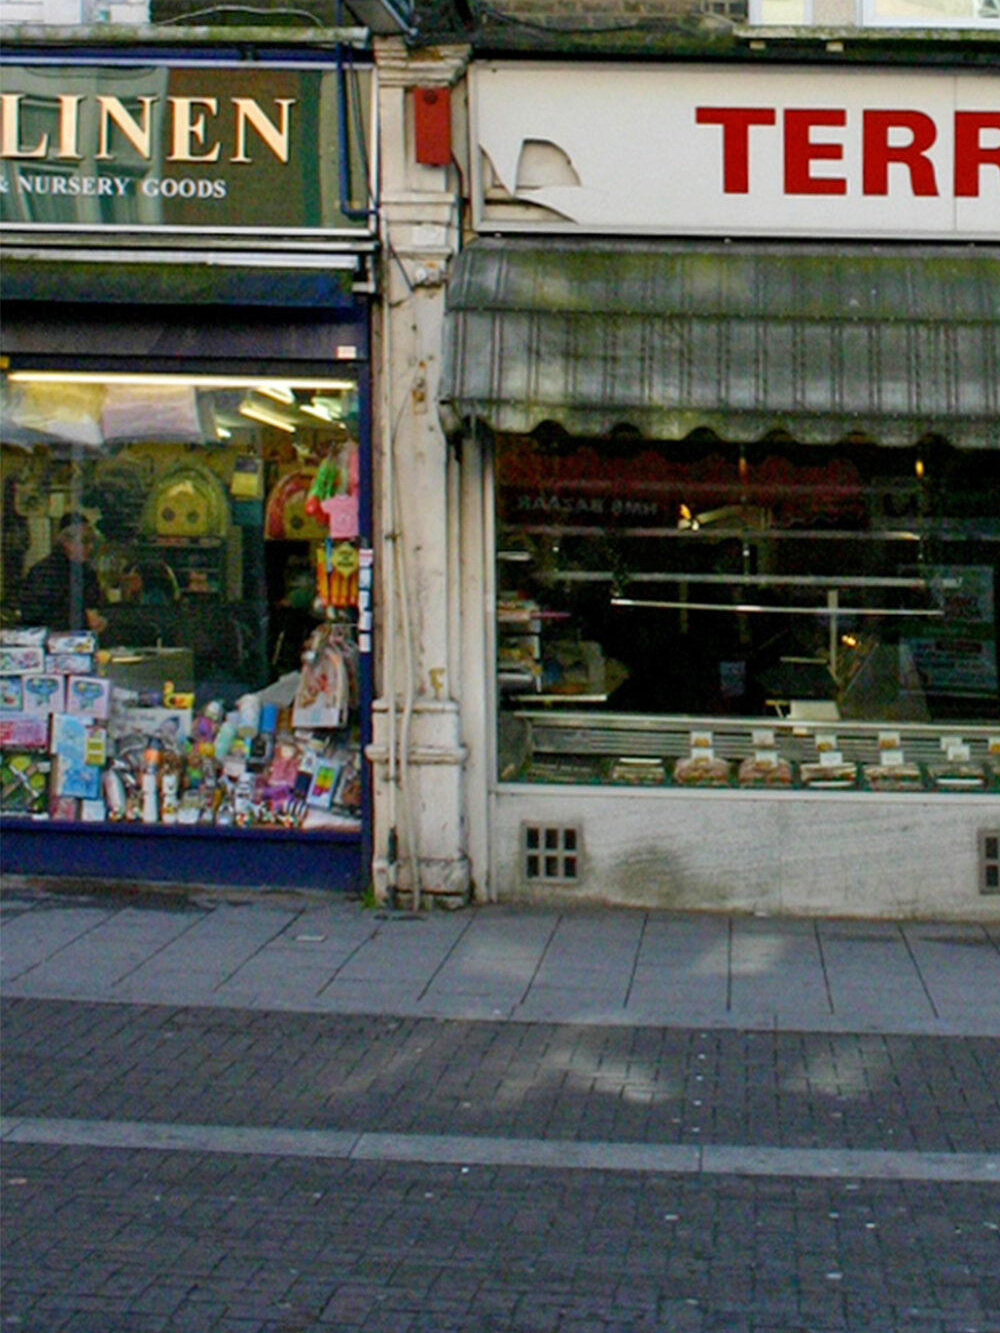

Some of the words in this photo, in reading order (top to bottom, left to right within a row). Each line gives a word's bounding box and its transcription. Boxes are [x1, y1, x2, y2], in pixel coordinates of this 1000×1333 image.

[0, 93, 296, 164] LINEN
[18, 175, 130, 196] NURSERY
[142, 178, 226, 199] GOODS
